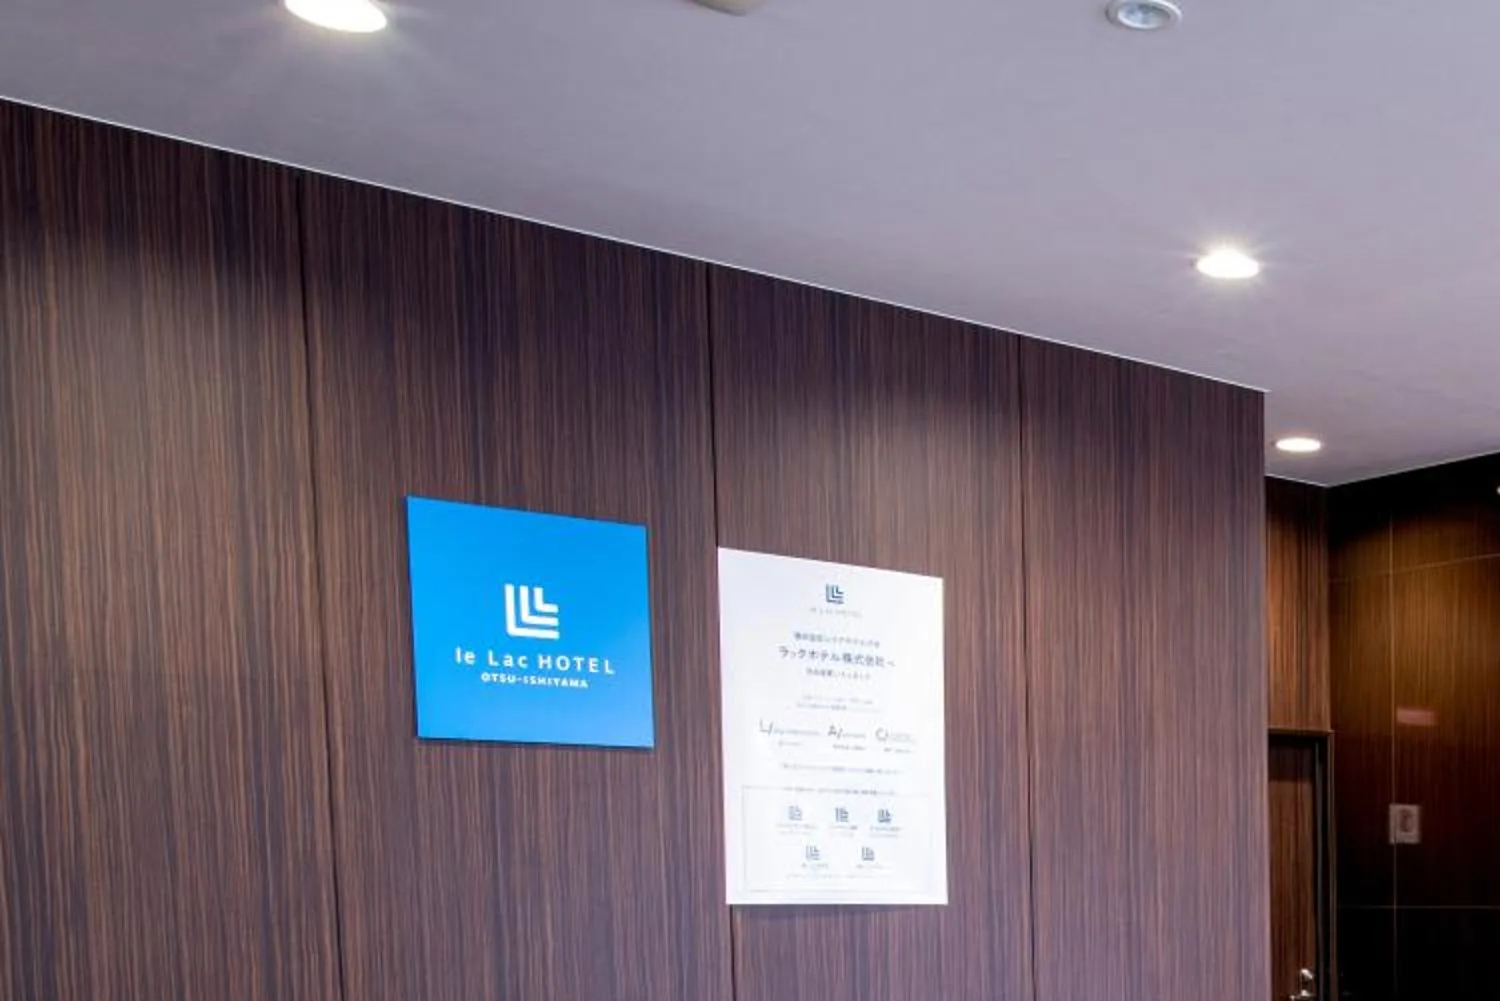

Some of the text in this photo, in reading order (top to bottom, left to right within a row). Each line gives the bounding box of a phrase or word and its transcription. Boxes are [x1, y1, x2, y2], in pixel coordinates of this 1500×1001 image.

[455, 647, 616, 675] le Lac HOTEL
[480, 671, 589, 689] OTSU-ISHIYAMA
